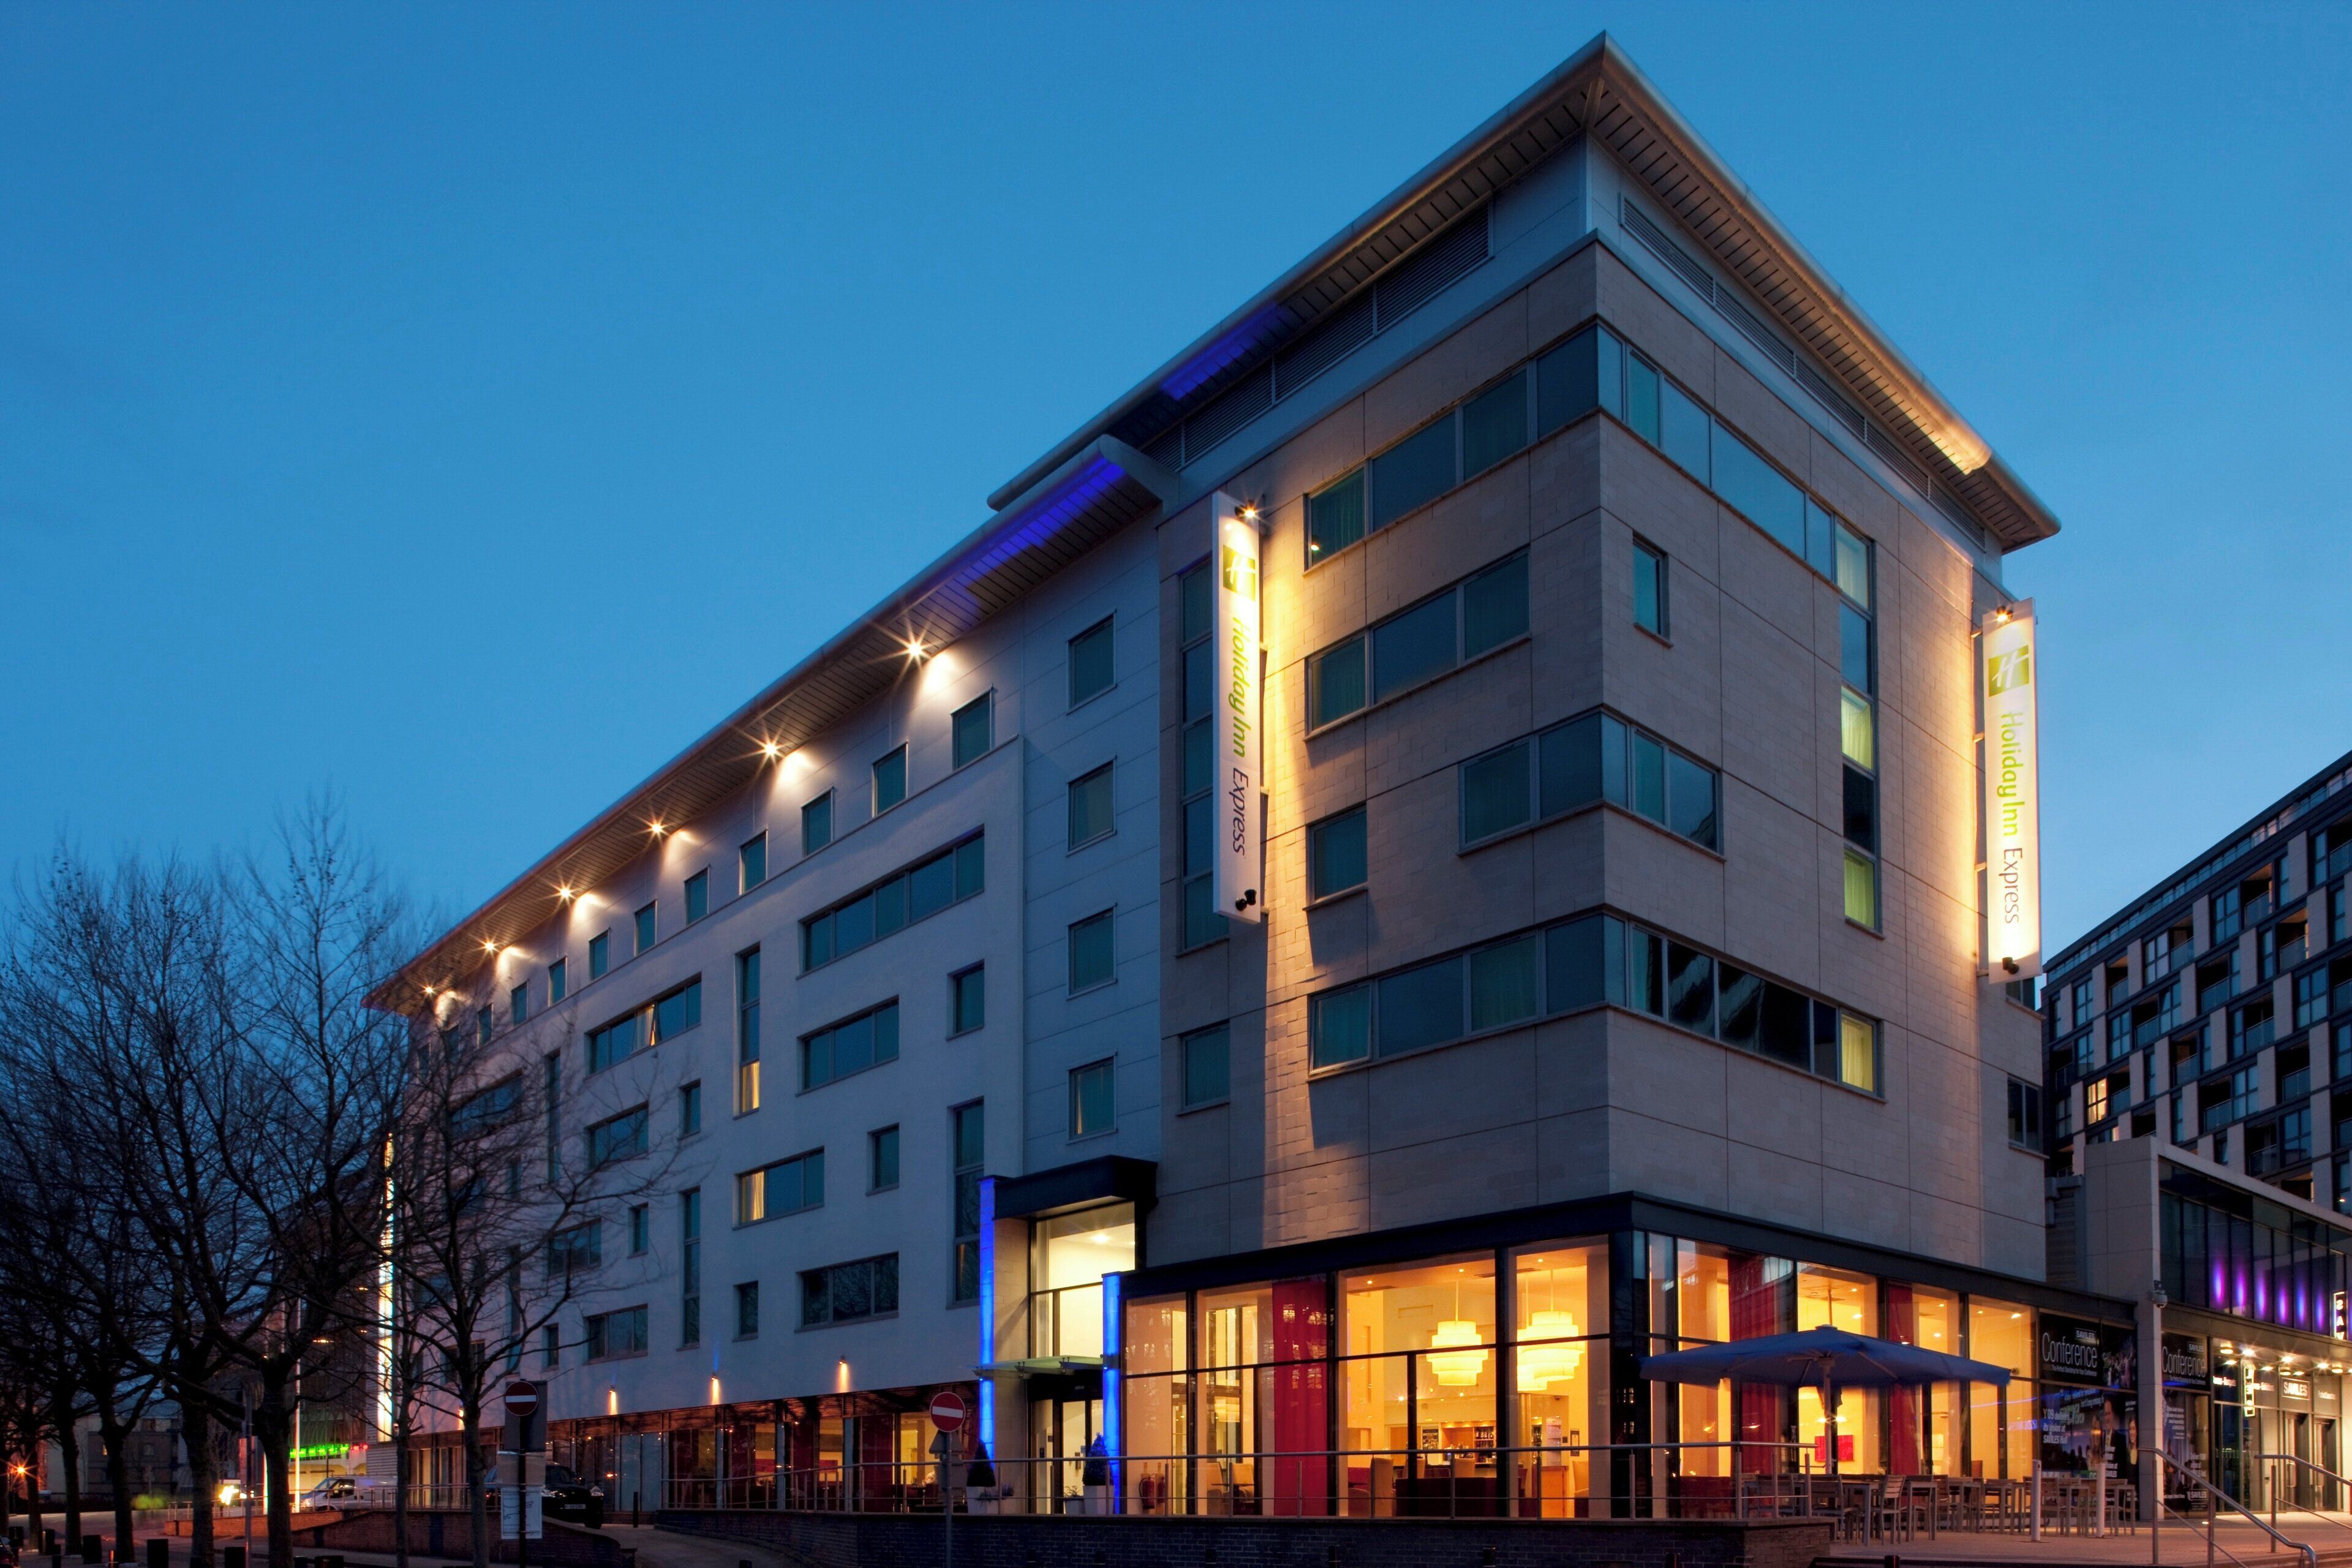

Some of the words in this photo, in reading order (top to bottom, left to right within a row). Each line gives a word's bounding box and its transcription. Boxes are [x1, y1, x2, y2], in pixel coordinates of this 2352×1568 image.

[1228, 617, 1251, 716] Holiday
[1233, 716, 1251, 758] Inn
[1997, 712, 2024, 798] Holiday
[1229, 767, 1249, 856] Express
[2003, 801, 2026, 837] Inn
[1999, 848, 2023, 924] Express
[2042, 1332, 2098, 1368] Conference
[2076, 1330, 2095, 1341] SAVILES
[2162, 1346, 2206, 1378] Conference
[2043, 1434, 2060, 1444] SAVILES
[2061, 1424, 2066, 1433] at
